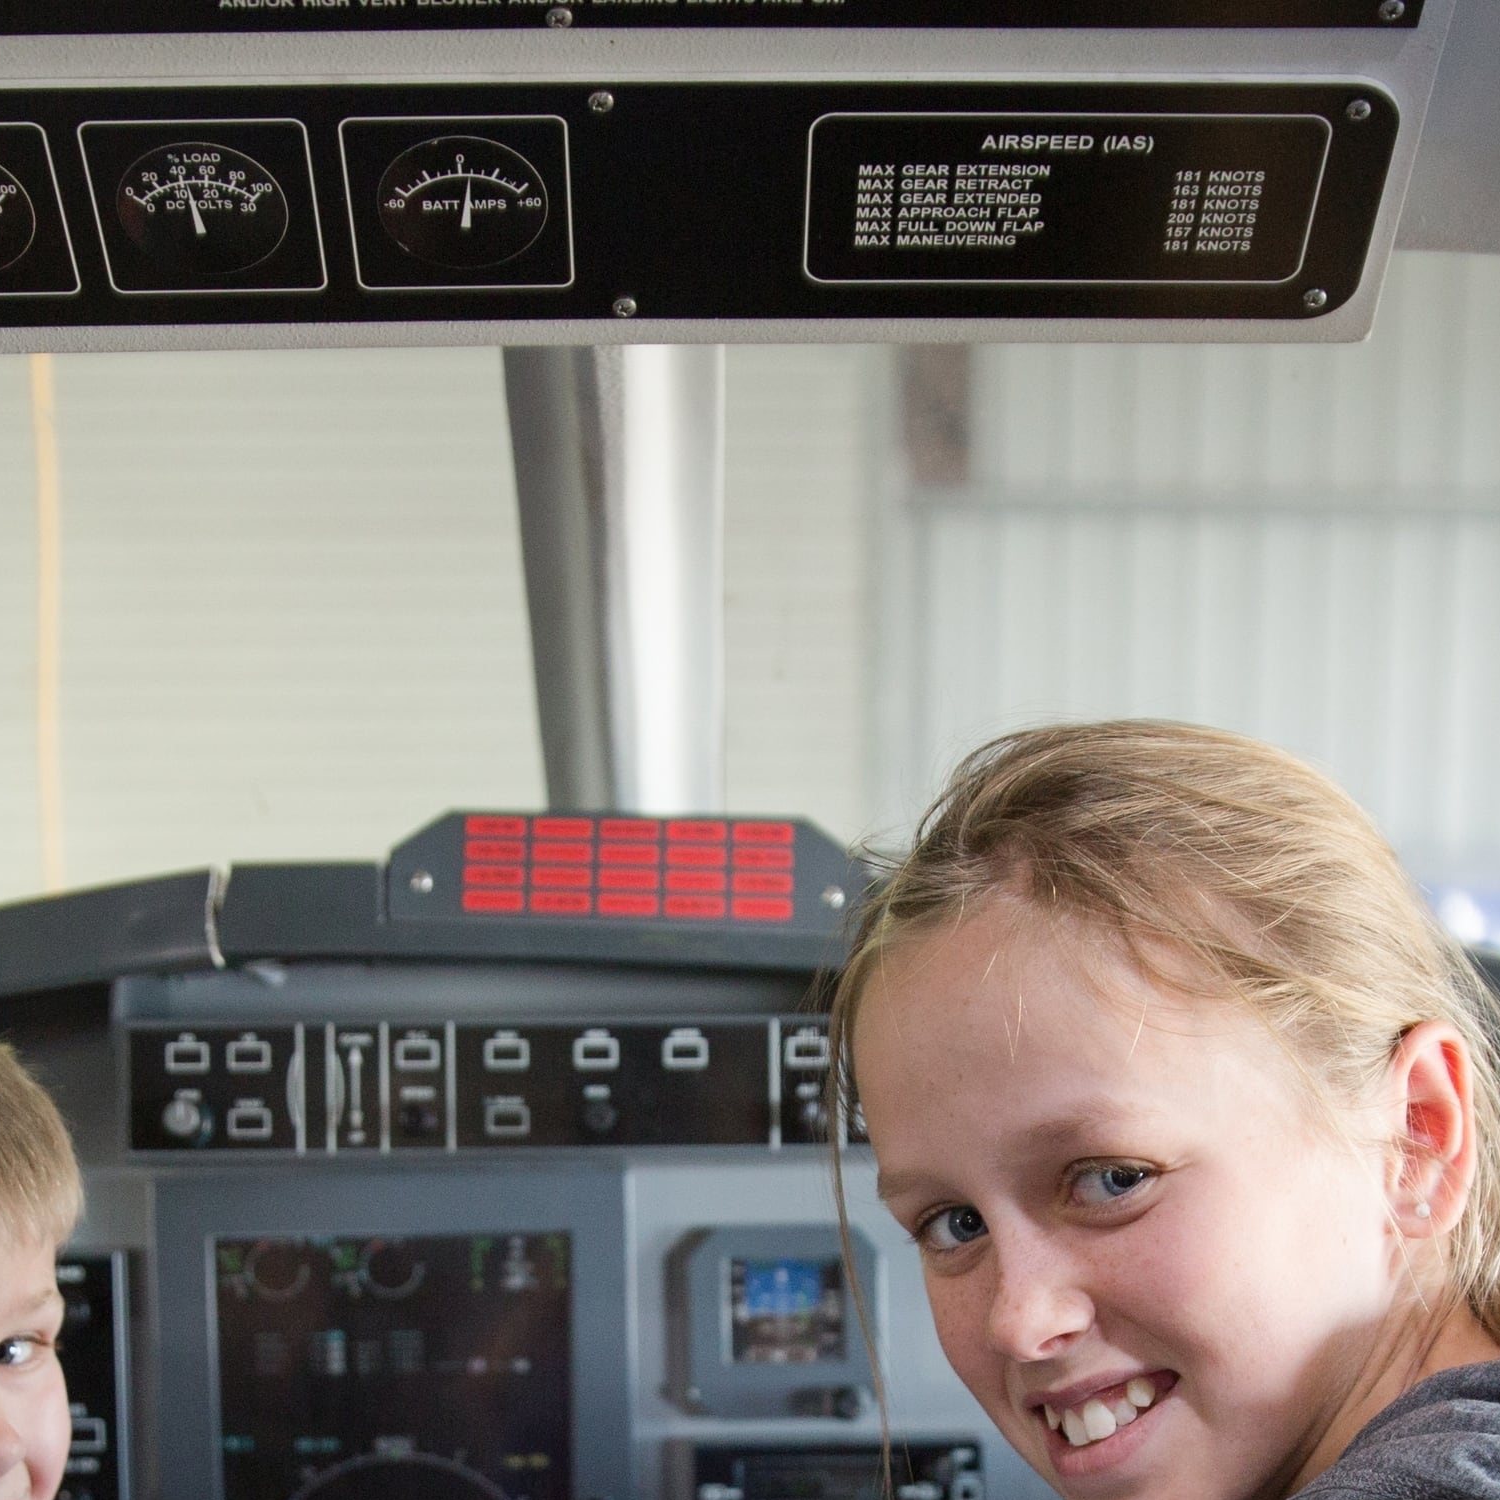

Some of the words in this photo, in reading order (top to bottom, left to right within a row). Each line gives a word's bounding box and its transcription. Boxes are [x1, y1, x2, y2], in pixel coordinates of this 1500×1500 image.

[982, 134, 1095, 150] AIRSPEED
[1103, 135, 1155, 153] (IAS)
[167, 153, 180, 163] %
[183, 153, 221, 163] LOAD
[455, 153, 465, 164] 0
[169, 165, 186, 175] 40
[199, 165, 216, 175] 60
[859, 164, 895, 176] MAX
[902, 164, 949, 176] GEAR
[956, 165, 1051, 176] EXTENSION
[141, 172, 158, 182] 20
[229, 171, 246, 181] 80
[1175, 170, 1202, 182] 181
[1209, 171, 1265, 182] KNOTS
[251, 183, 273, 193] 100
[858, 179, 894, 190] MAX
[901, 179, 948, 190] GEAR
[955, 179, 1034, 190] RETRACT
[125, 187, 134, 197] 0
[174, 189, 188, 199] 10
[203, 189, 219, 199] 20
[1173, 185, 1199, 196] 163
[1206, 185, 1263, 196] KNOTS
[517, 198, 542, 208] +60
[857, 193, 893, 204] MAX
[900, 193, 947, 204] GEAR
[953, 193, 1042, 204] EXTENDED
[147, 203, 156, 213] 0
[166, 200, 186, 210] DC
[240, 203, 257, 213] 30
[384, 199, 405, 209] -60
[422, 200, 459, 210] BATT
[1170, 199, 1196, 210] 181
[1203, 199, 1259, 210] KNOTS
[856, 207, 892, 218] MAX
[898, 207, 991, 218] APPROACH
[997, 207, 1040, 218] FLAP
[1167, 213, 1195, 224] 200
[1201, 213, 1256, 224] KNOTS
[855, 221, 891, 232] MAX
[898, 221, 939, 232] FULL
[945, 221, 996, 232] DOWN
[1002, 221, 1045, 232] FLAP
[1166, 226, 1192, 238] 157
[1198, 227, 1253, 238] KNOTS
[854, 235, 891, 246] MAX
[896, 235, 1017, 246] MANEUVERING
[1163, 240, 1189, 251] 181
[1195, 240, 1251, 251] KNOTS
